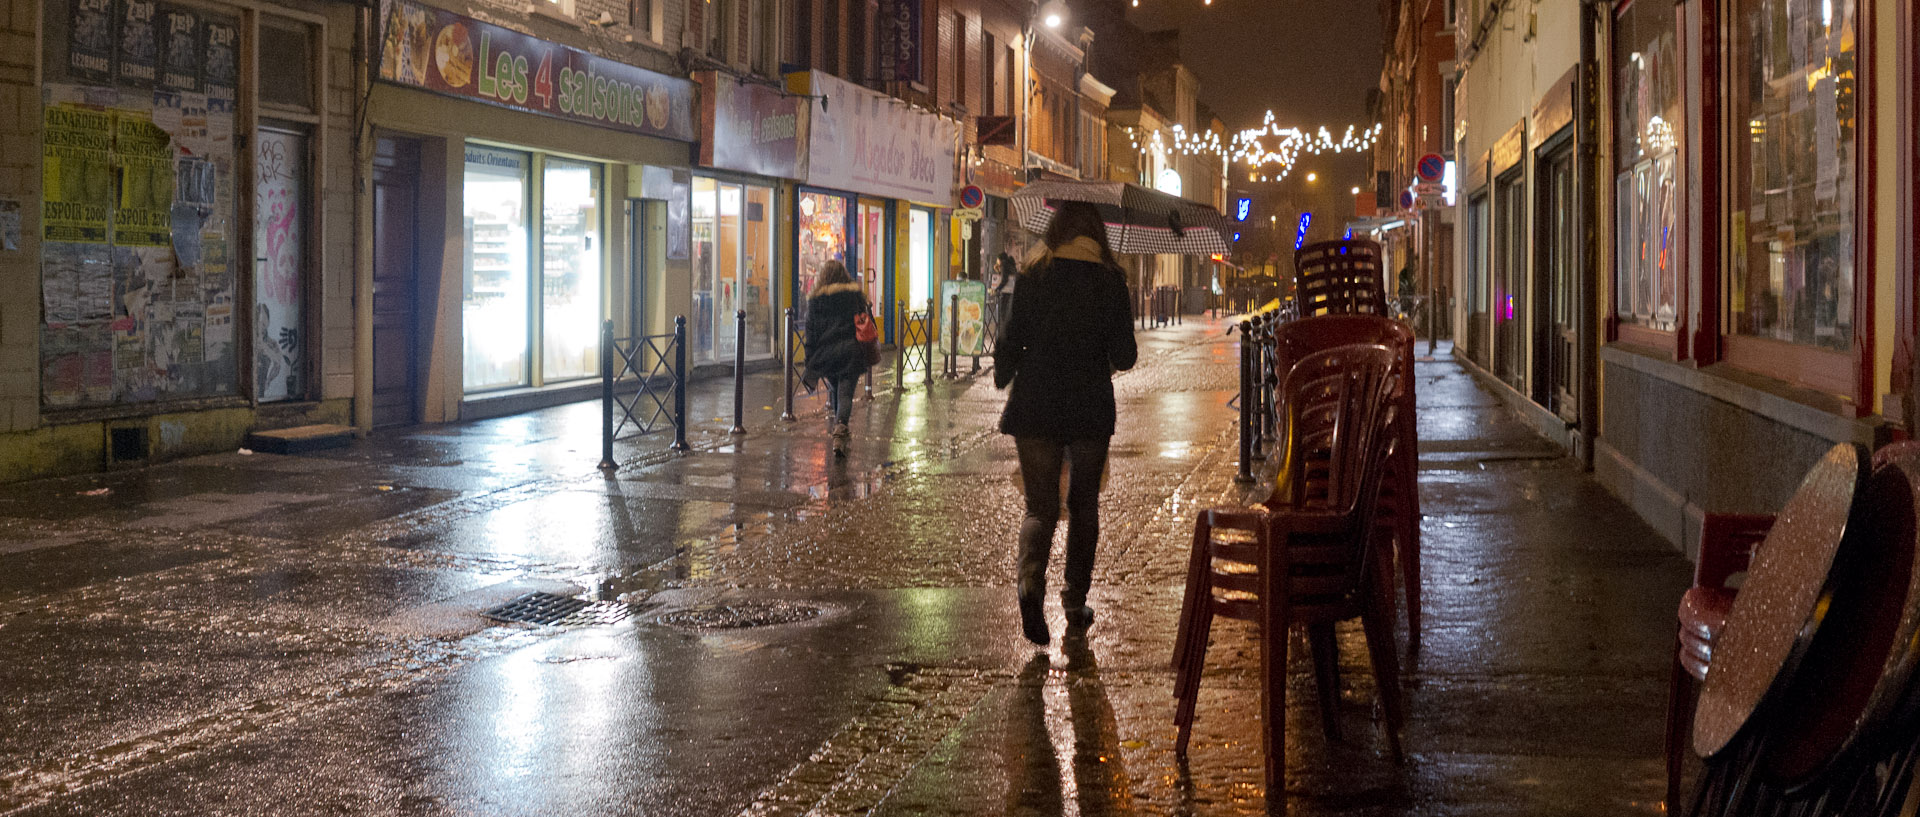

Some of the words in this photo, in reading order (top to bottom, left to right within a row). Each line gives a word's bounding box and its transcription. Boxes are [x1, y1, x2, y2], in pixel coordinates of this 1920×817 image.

[478, 30, 529, 104] Les
[534, 48, 553, 109] 4
[558, 60, 644, 127] saisons
[753, 110, 761, 144] 4
[761, 109, 796, 143] saisons
[853, 122, 905, 184] Mogador
[45, 201, 82, 220] ESPOIR
[85, 208, 106, 222] 2000
[114, 208, 148, 225] ESPOIR
